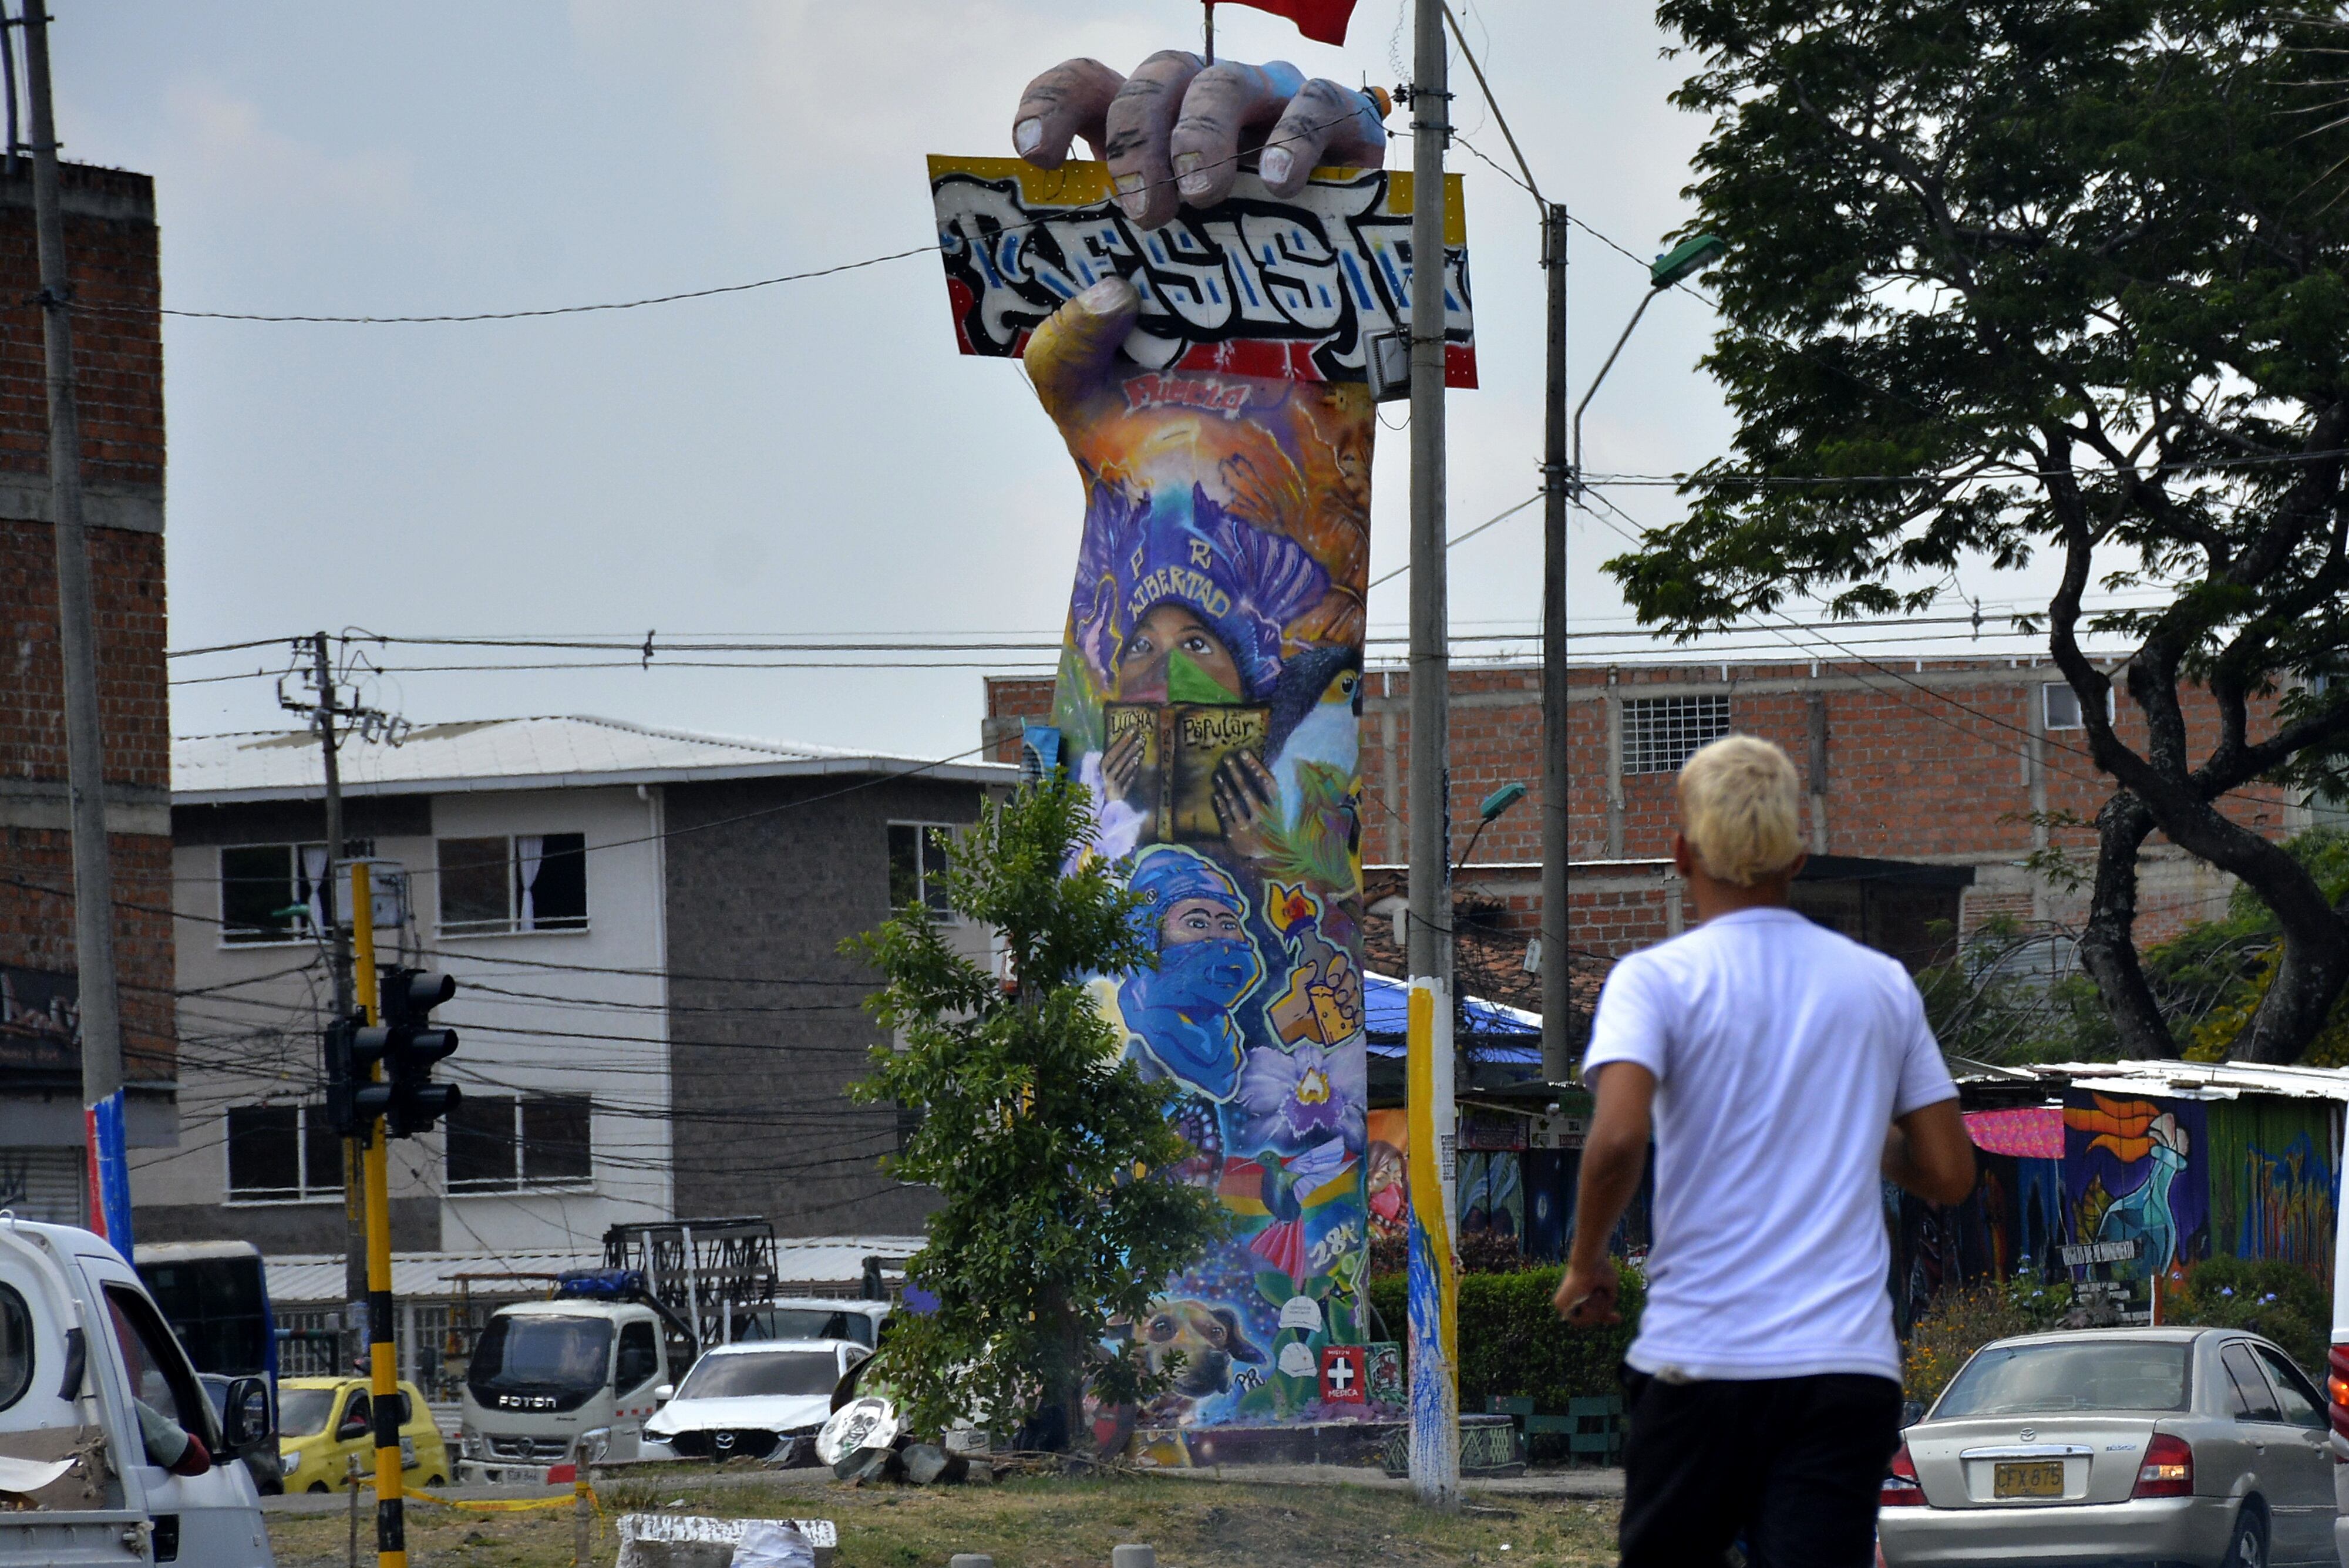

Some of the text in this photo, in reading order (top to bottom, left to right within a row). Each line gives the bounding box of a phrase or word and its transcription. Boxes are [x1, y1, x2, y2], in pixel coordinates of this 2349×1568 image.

[1189, 537, 1211, 570] R
[1128, 564, 1231, 622] LIBERTAD
[499, 1395, 557, 1408] FOTON
[1328, 1389, 1358, 1398] MEDICA
